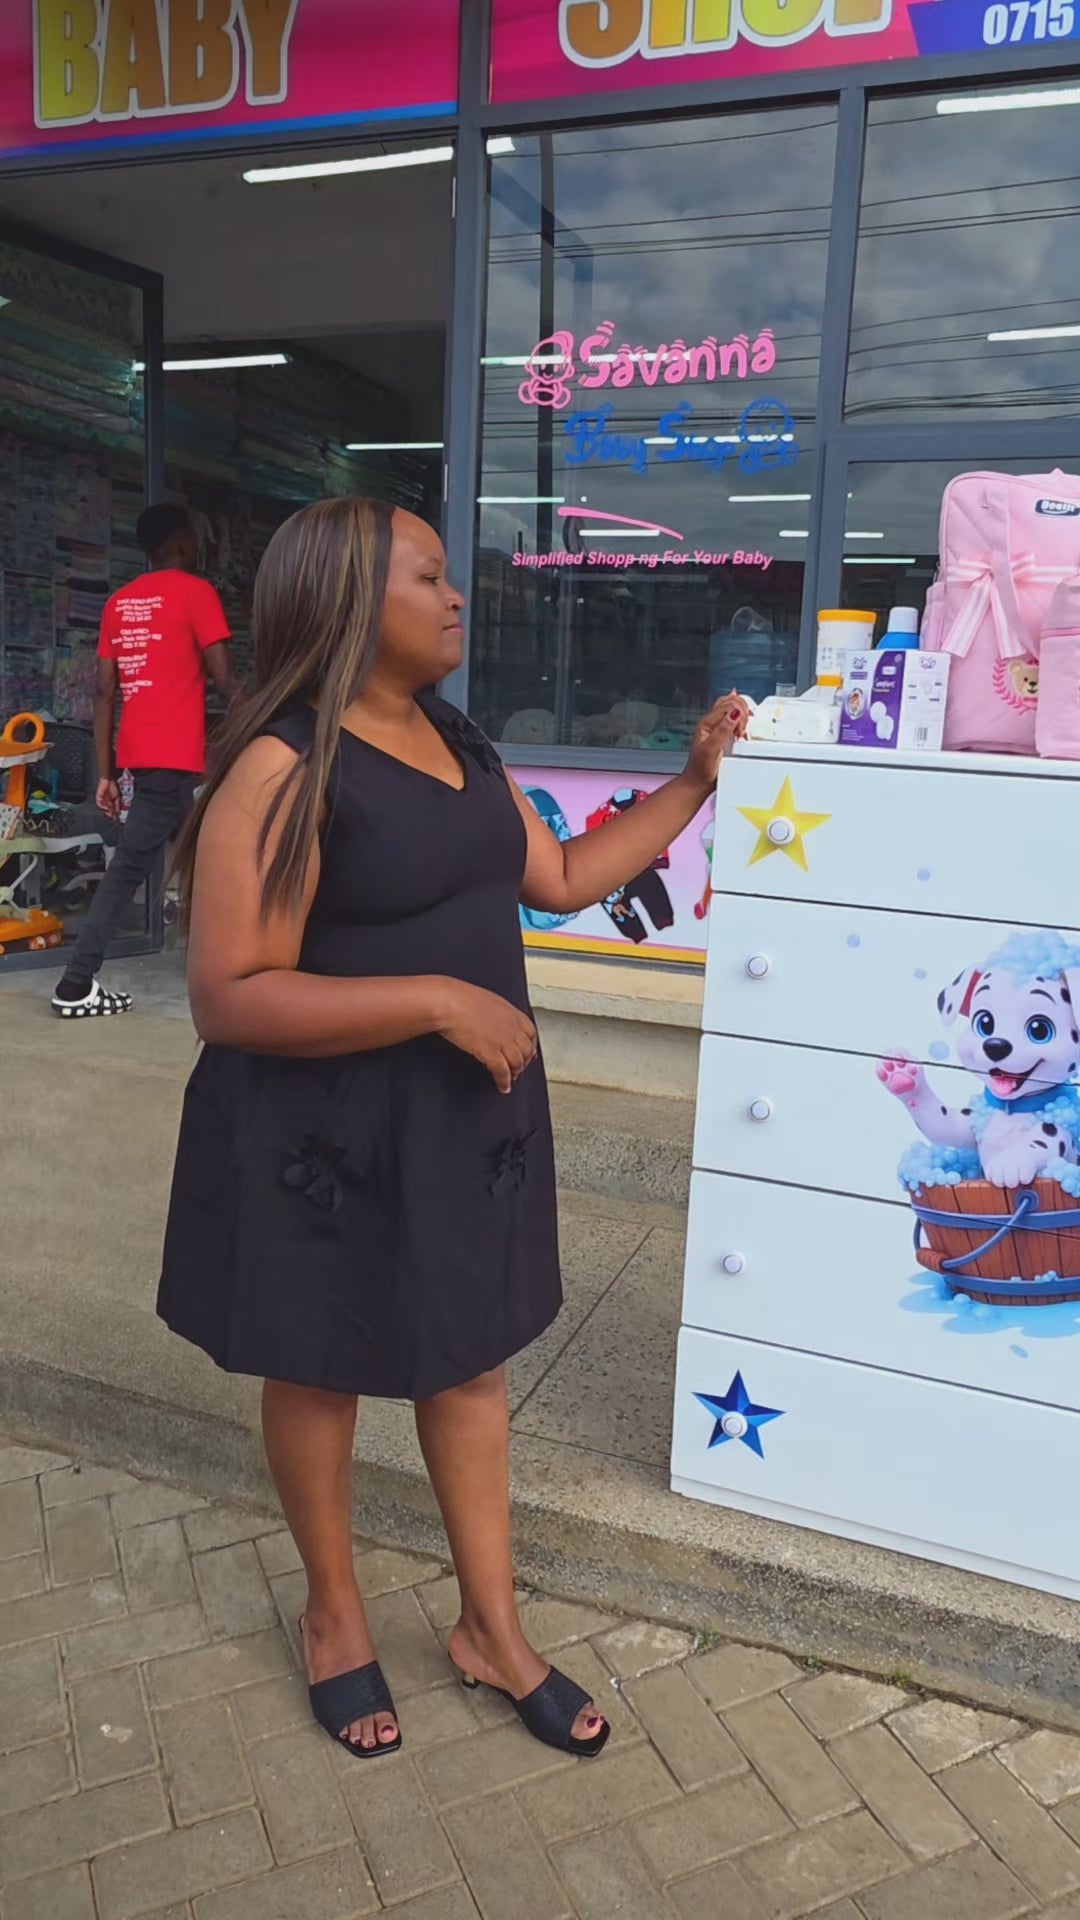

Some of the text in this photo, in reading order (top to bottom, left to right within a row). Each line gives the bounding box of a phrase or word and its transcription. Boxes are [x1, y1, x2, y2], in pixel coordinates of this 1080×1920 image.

[982, 0, 1075, 45] 0715
[33, 0, 298, 129] BABY
[579, 326, 777, 388] Savanna
[511, 551, 584, 569] Simplified
[661, 549, 690, 565] For
[693, 550, 730, 565] Your
[732, 549, 774, 571] Baby
